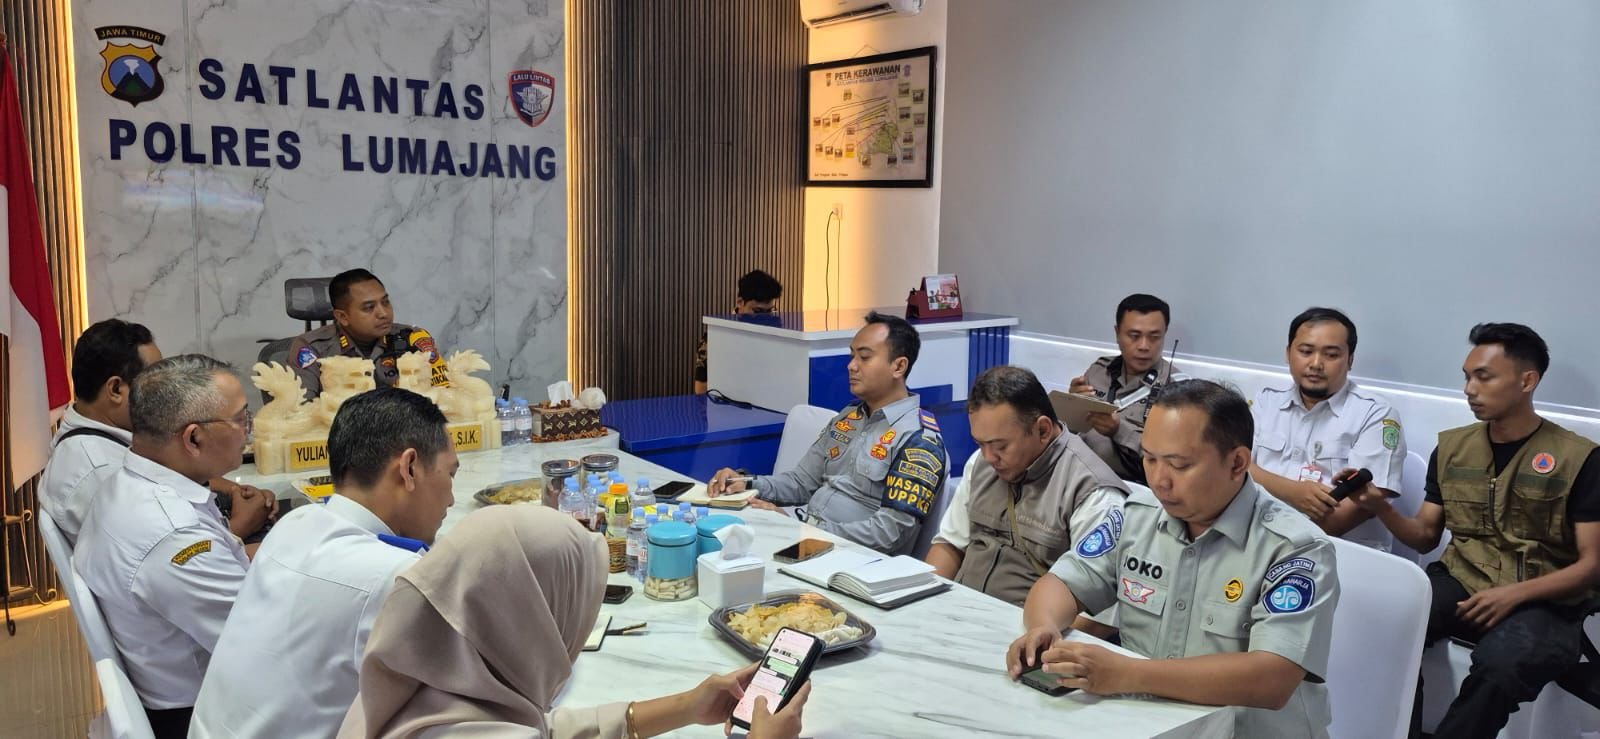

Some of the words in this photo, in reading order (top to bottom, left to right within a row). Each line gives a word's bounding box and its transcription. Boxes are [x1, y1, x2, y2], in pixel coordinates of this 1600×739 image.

[100, 28, 128, 38] JAWA
[131, 29, 160, 42] TIMUR
[513, 73, 529, 81] LALU
[834, 71, 852, 81] PETA
[853, 64, 900, 78] KERAWANAN
[198, 58, 486, 120] SATLANTAS
[108, 118, 302, 171] POLRES
[341, 134, 557, 181] LUMAJANG
[1123, 555, 1163, 579] OKO
